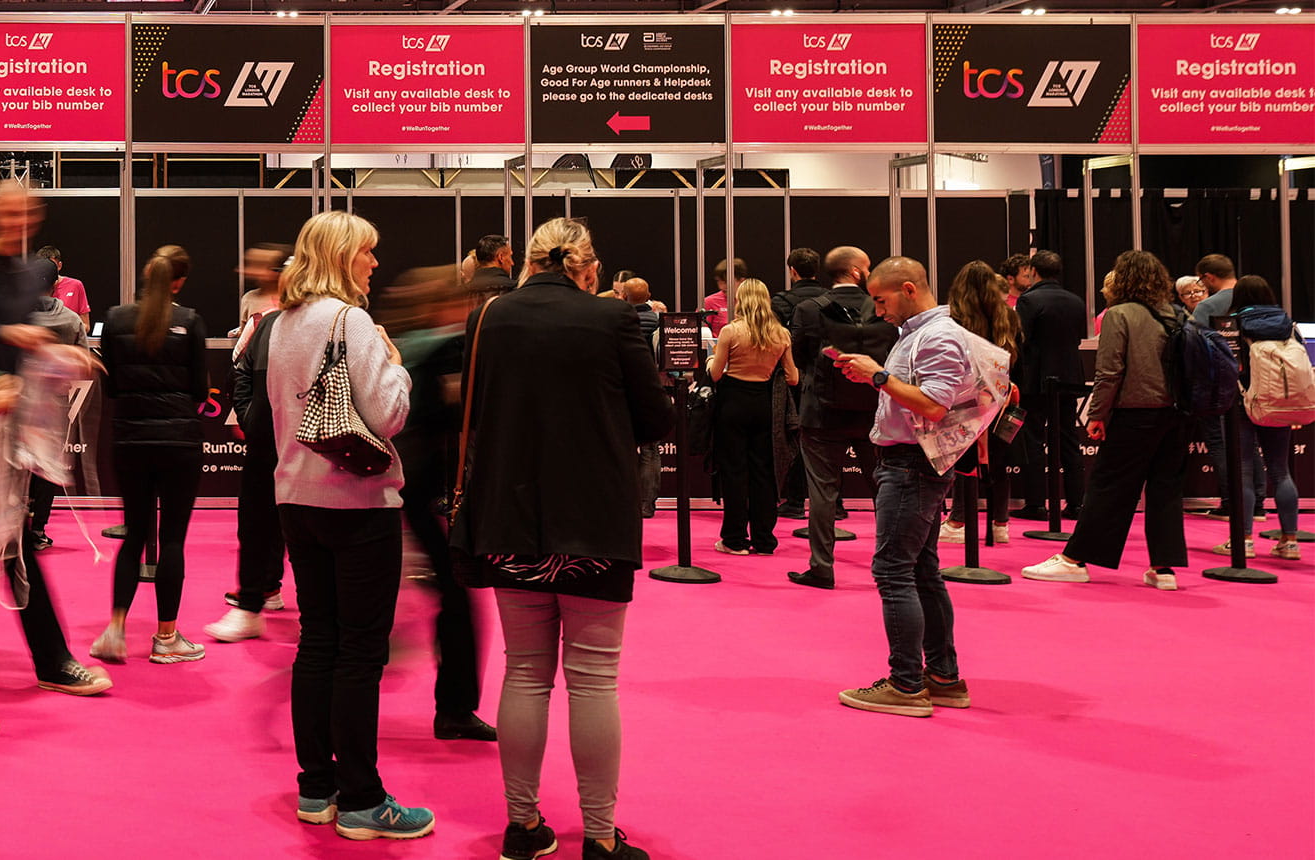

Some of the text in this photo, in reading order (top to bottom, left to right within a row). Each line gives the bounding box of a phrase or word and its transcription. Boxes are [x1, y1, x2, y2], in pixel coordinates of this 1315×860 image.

[5, 32, 28, 48] tcs
[402, 34, 425, 50] tcs
[580, 33, 604, 48] tcs
[803, 33, 826, 48] tcs
[1210, 33, 1234, 49] tcs
[368, 60, 486, 80] Registration
[542, 63, 710, 76] Age Group World Championship,
[769, 59, 887, 80] Registration
[1176, 59, 1297, 80] Registration
[162, 61, 222, 99] tcs
[540, 77, 712, 89] Good For Age runners & Helpdesk
[963, 60, 1025, 99] tcs
[3, 86, 63, 97] available
[66, 86, 96, 97] desk
[99, 86, 113, 97] to
[343, 88, 511, 101] Visit any available desk to
[542, 91, 713, 103] please go to the dedicated desks
[744, 87, 914, 100] Visit any available desk to
[1150, 87, 1179, 99] Visit
[1181, 89, 1207, 101] any
[1209, 87, 1272, 99] available
[1274, 87, 1306, 99] desk
[1, 101, 30, 112] your
[32, 99, 53, 111] bib
[56, 99, 105, 111] number
[351, 101, 503, 115] collect your bib number
[753, 100, 906, 114] collect your bib number
[1159, 101, 1315, 114] collect your bib number
